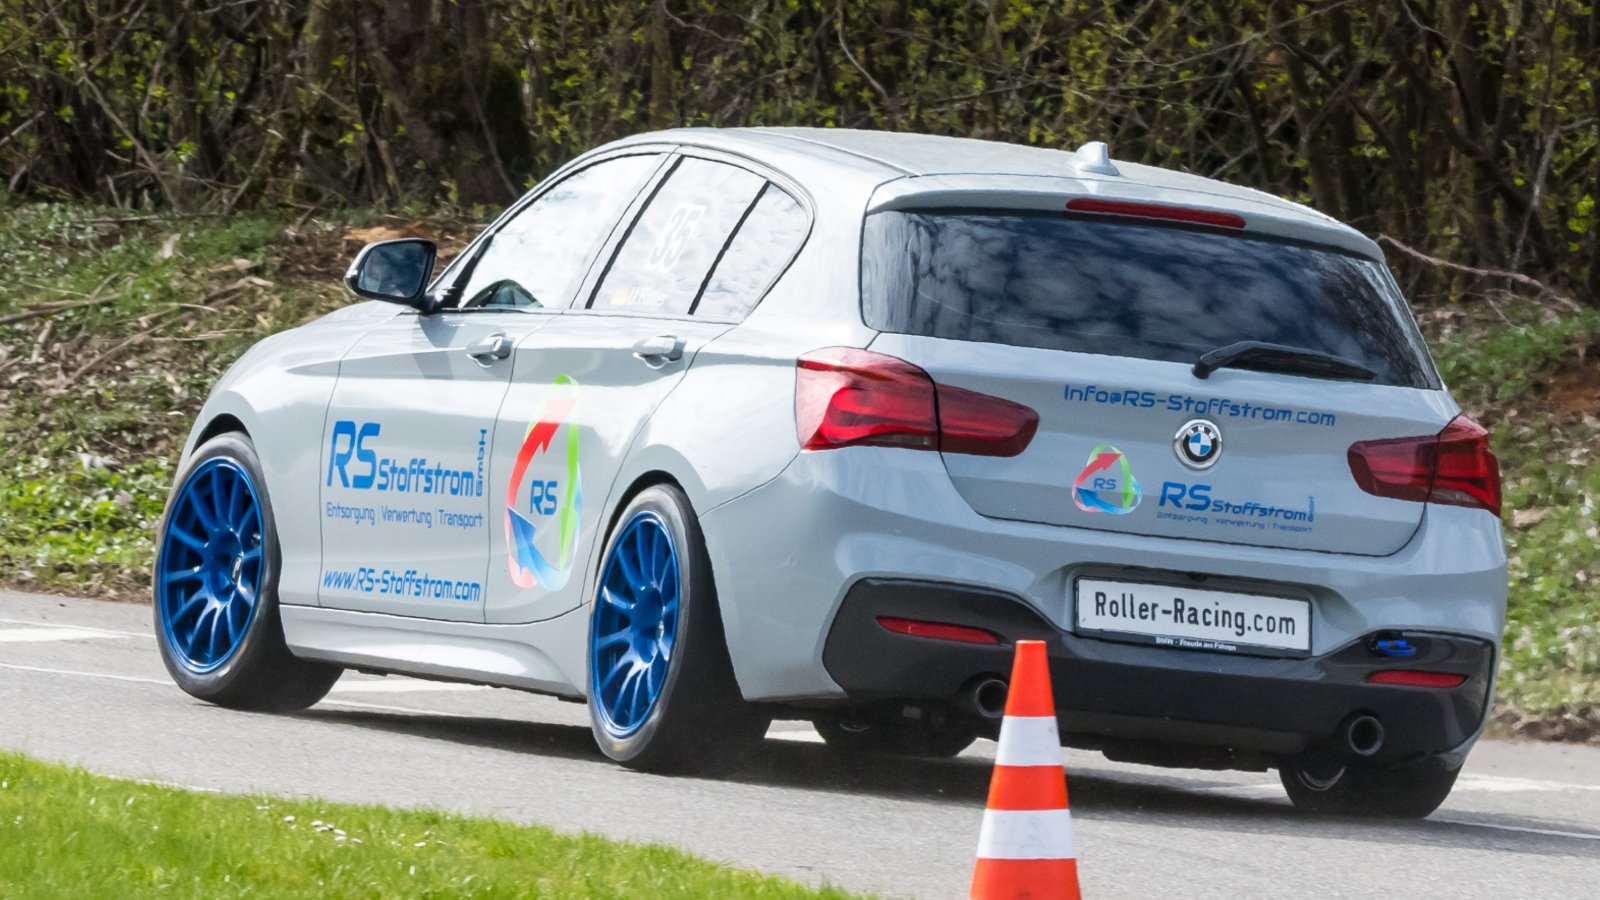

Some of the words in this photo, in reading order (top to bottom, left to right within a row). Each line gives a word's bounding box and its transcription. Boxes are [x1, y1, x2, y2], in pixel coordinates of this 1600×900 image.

[647, 203, 706, 271] 35
[327, 420, 381, 489] RS
[377, 458, 474, 497] Stoffstrom
[475, 429, 488, 497] GmbH
[530, 480, 558, 515] RS
[1094, 477, 1117, 490] RS
[327, 501, 376, 526] Entsorgung
[381, 508, 433, 528] Verwertung
[438, 509, 483, 530] Transport
[1158, 481, 1212, 510] RS
[1211, 501, 1306, 522] Stoffstrom
[1156, 511, 1208, 525] Entsorgung
[1214, 517, 1265, 530] Verwertung
[1272, 522, 1312, 533] Transport
[323, 567, 481, 602] www.RS-Stoffstrom.com
[1095, 591, 1296, 637] Roller-Racing.com
[1155, 636, 1174, 645] BMW
